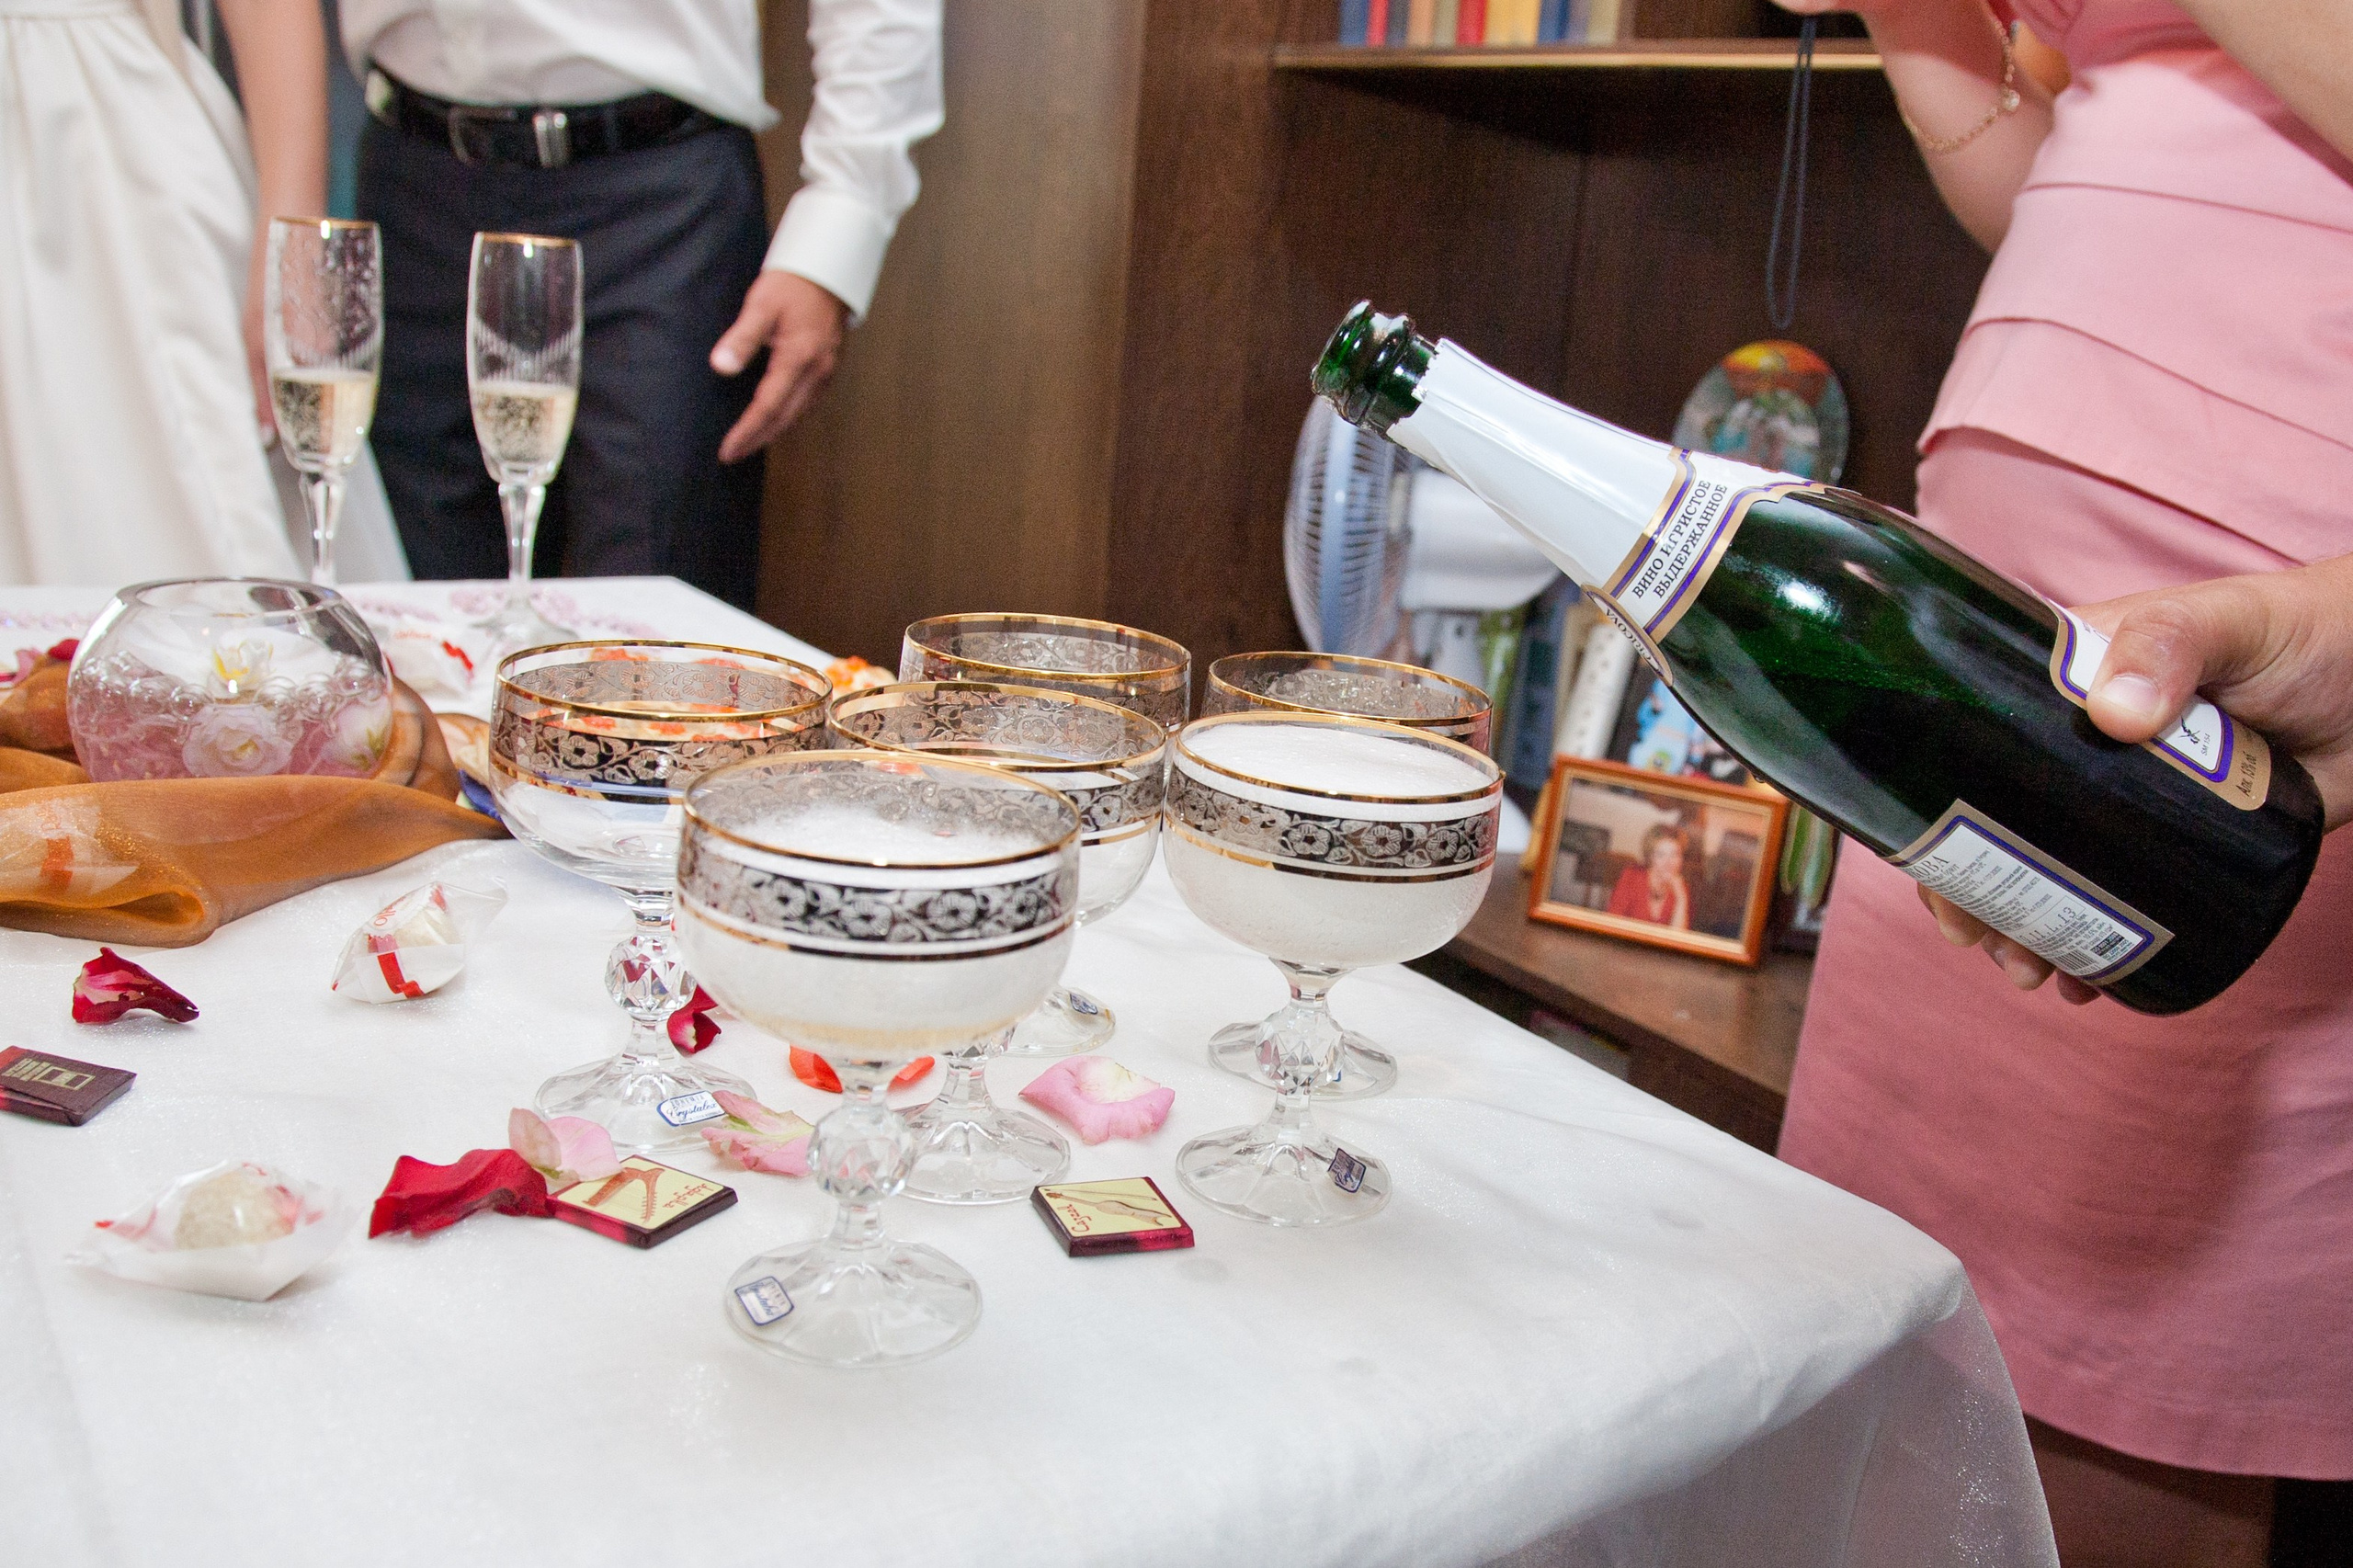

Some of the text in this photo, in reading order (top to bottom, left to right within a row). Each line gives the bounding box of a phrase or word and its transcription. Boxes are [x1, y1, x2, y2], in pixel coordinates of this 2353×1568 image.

[1632, 480, 1711, 599] ВИНО ИГРИСТОЕ
[1653, 483, 1729, 600] ВЫДЕРЖАННОЕ
[1605, 607, 1654, 663] CRICOVA
